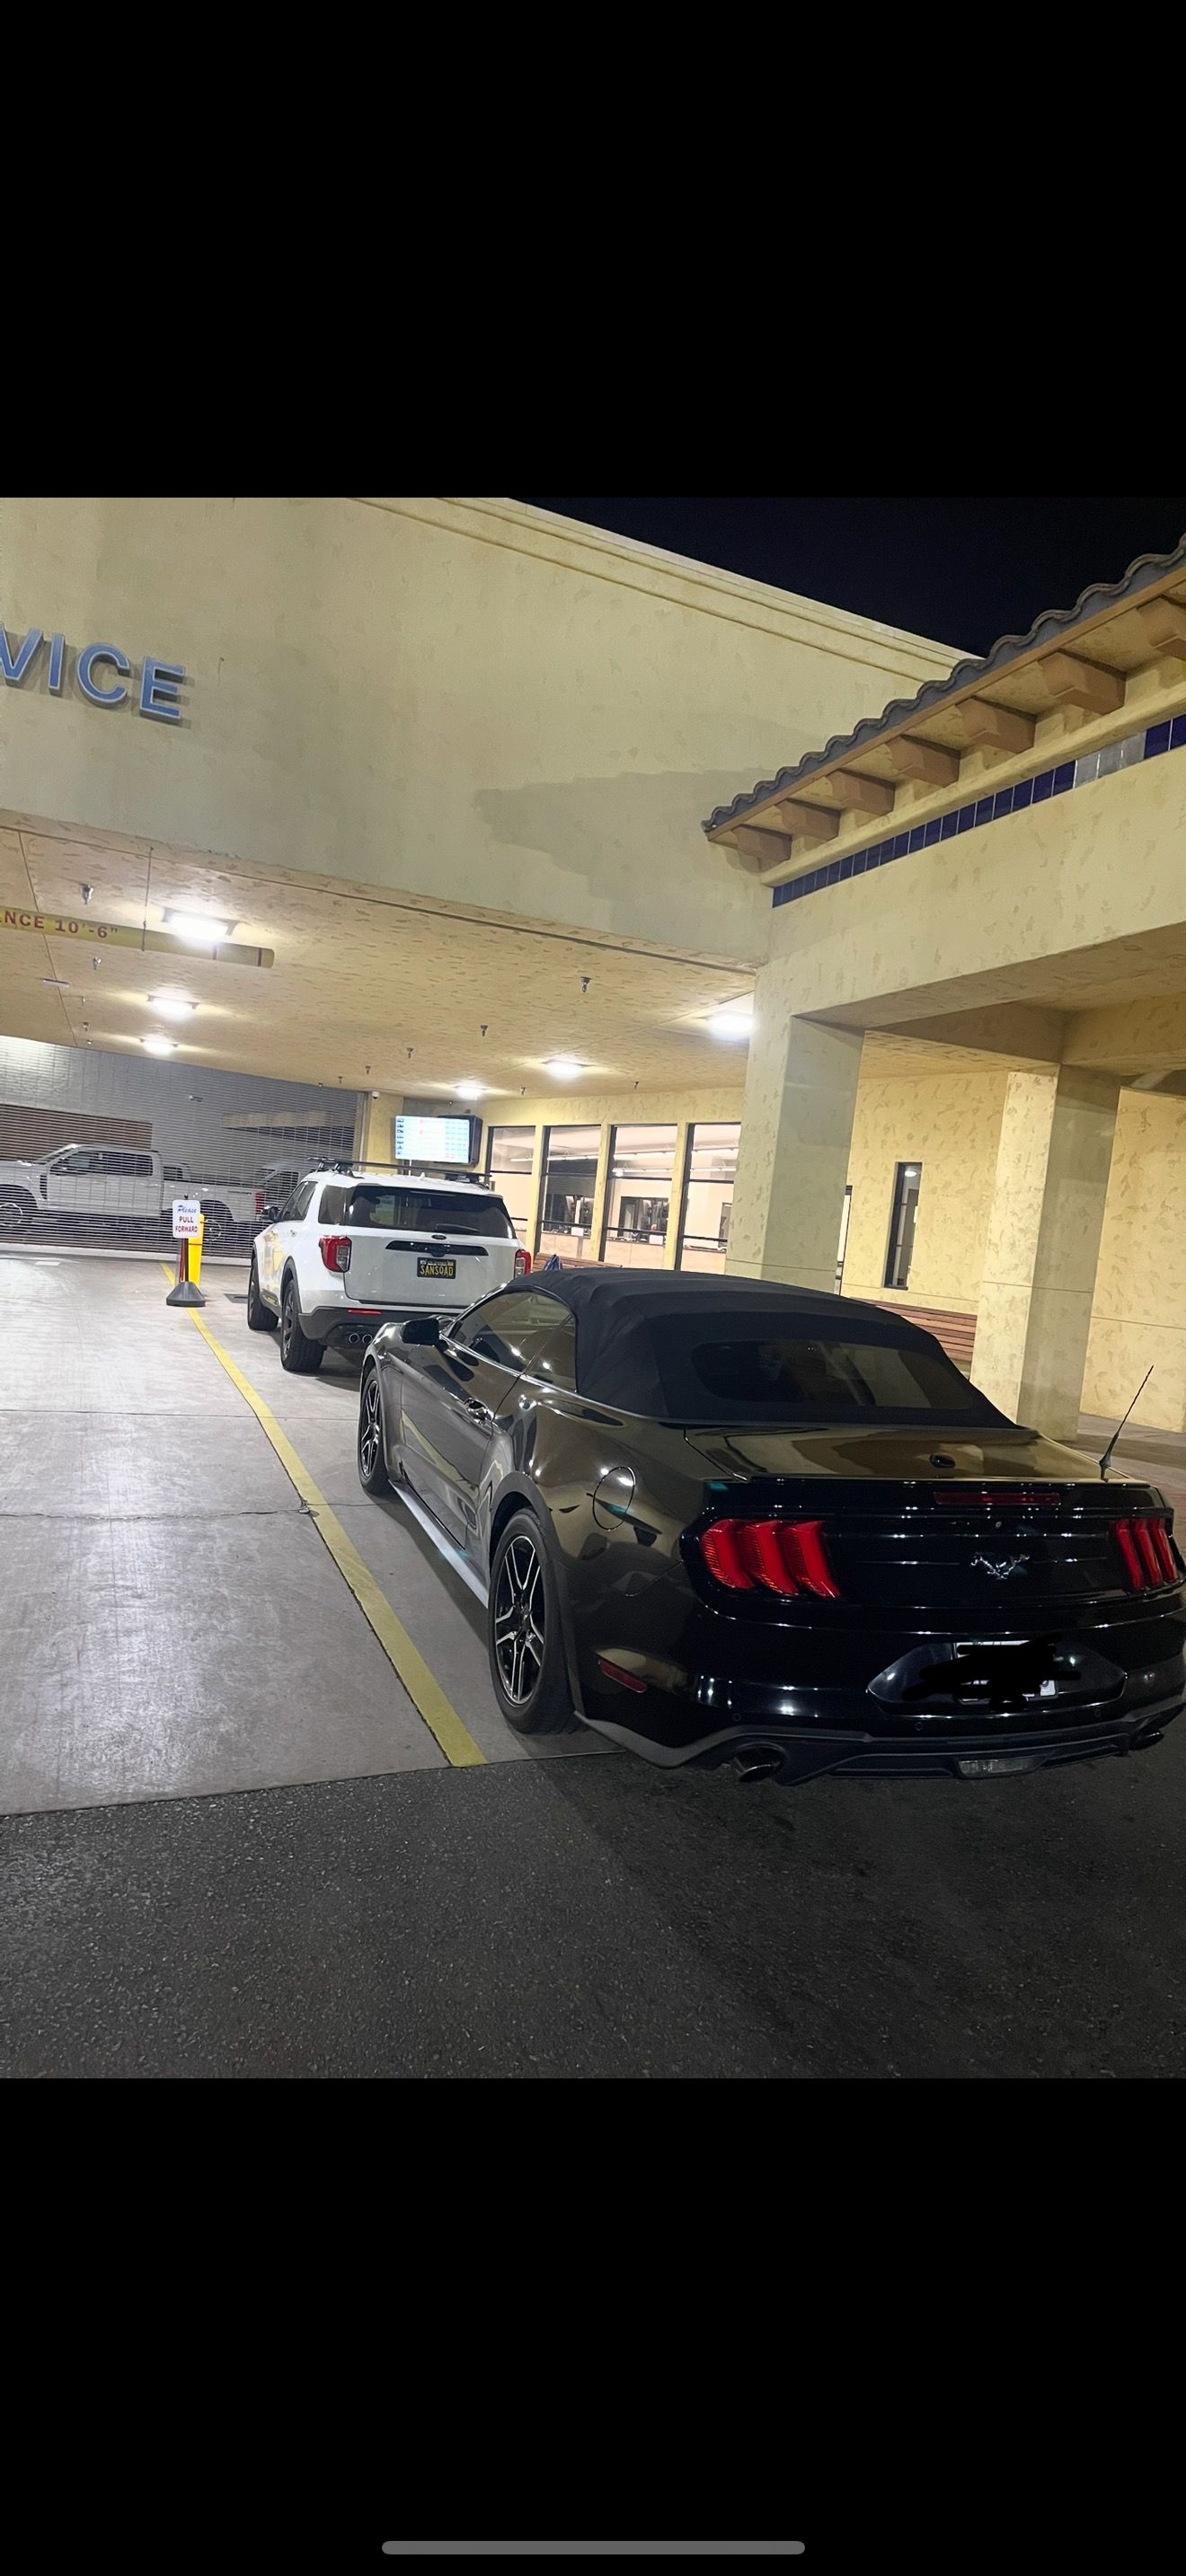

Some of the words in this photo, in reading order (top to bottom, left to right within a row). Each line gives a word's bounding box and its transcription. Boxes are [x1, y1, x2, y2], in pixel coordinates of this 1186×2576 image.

[0, 621, 186, 720] VICE
[0, 910, 44, 930] NCE
[178, 1204, 197, 1213] Please
